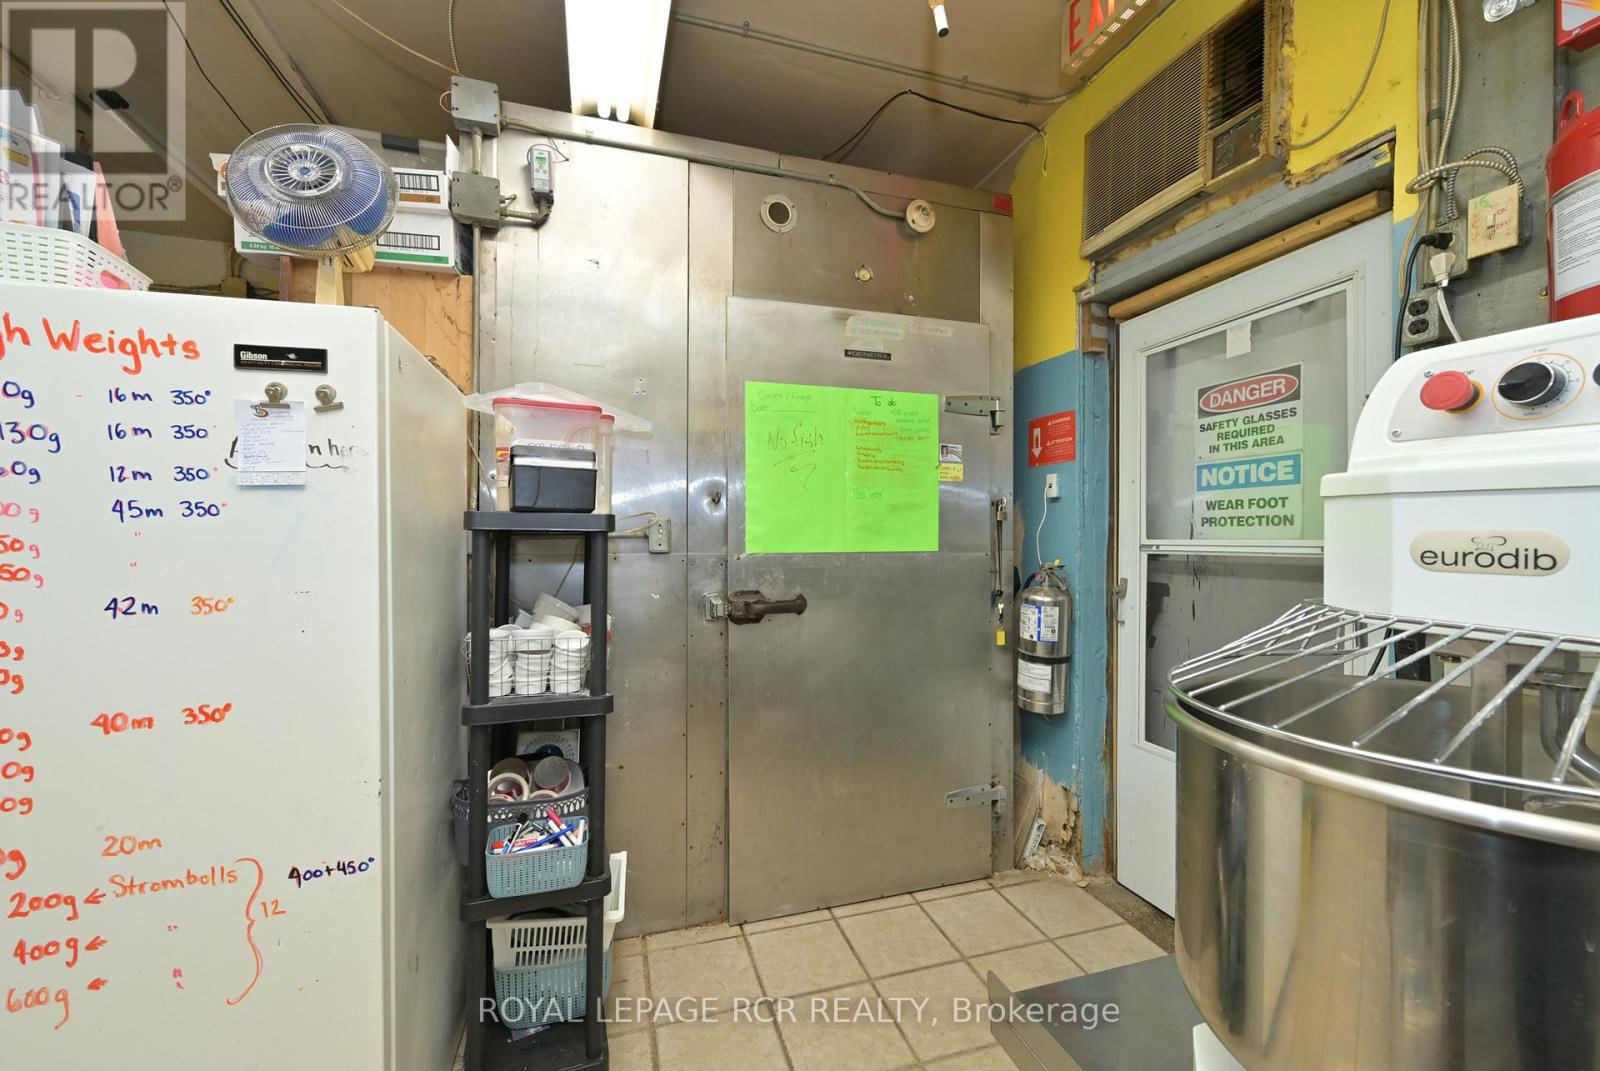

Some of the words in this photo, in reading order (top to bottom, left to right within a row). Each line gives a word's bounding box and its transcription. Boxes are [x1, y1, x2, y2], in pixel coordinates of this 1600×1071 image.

[42, 315, 200, 375] Weights
[240, 351, 268, 360] Gibson
[887, 395, 897, 407] do
[1209, 377, 1286, 409] DANGER
[1199, 417, 1240, 433] SAFETY
[1242, 406, 1298, 426] GLASSES
[1209, 444, 1220, 454] IN
[1223, 439, 1249, 452] THIS
[1251, 435, 1285, 449] AREA
[1216, 423, 1276, 442] REQUIRED
[1201, 459, 1294, 487] NOTICE
[1205, 499, 1245, 511] WEAR
[1247, 496, 1289, 510] FOOT
[1201, 514, 1295, 528] PROTECTION
[1419, 547, 1558, 572] eurodib
[101, 834, 164, 857] 20m
[7, 891, 79, 921] 200g
[260, 899, 287, 918] 12
[13, 936, 79, 968] 400g
[5, 986, 70, 1031] 600g
